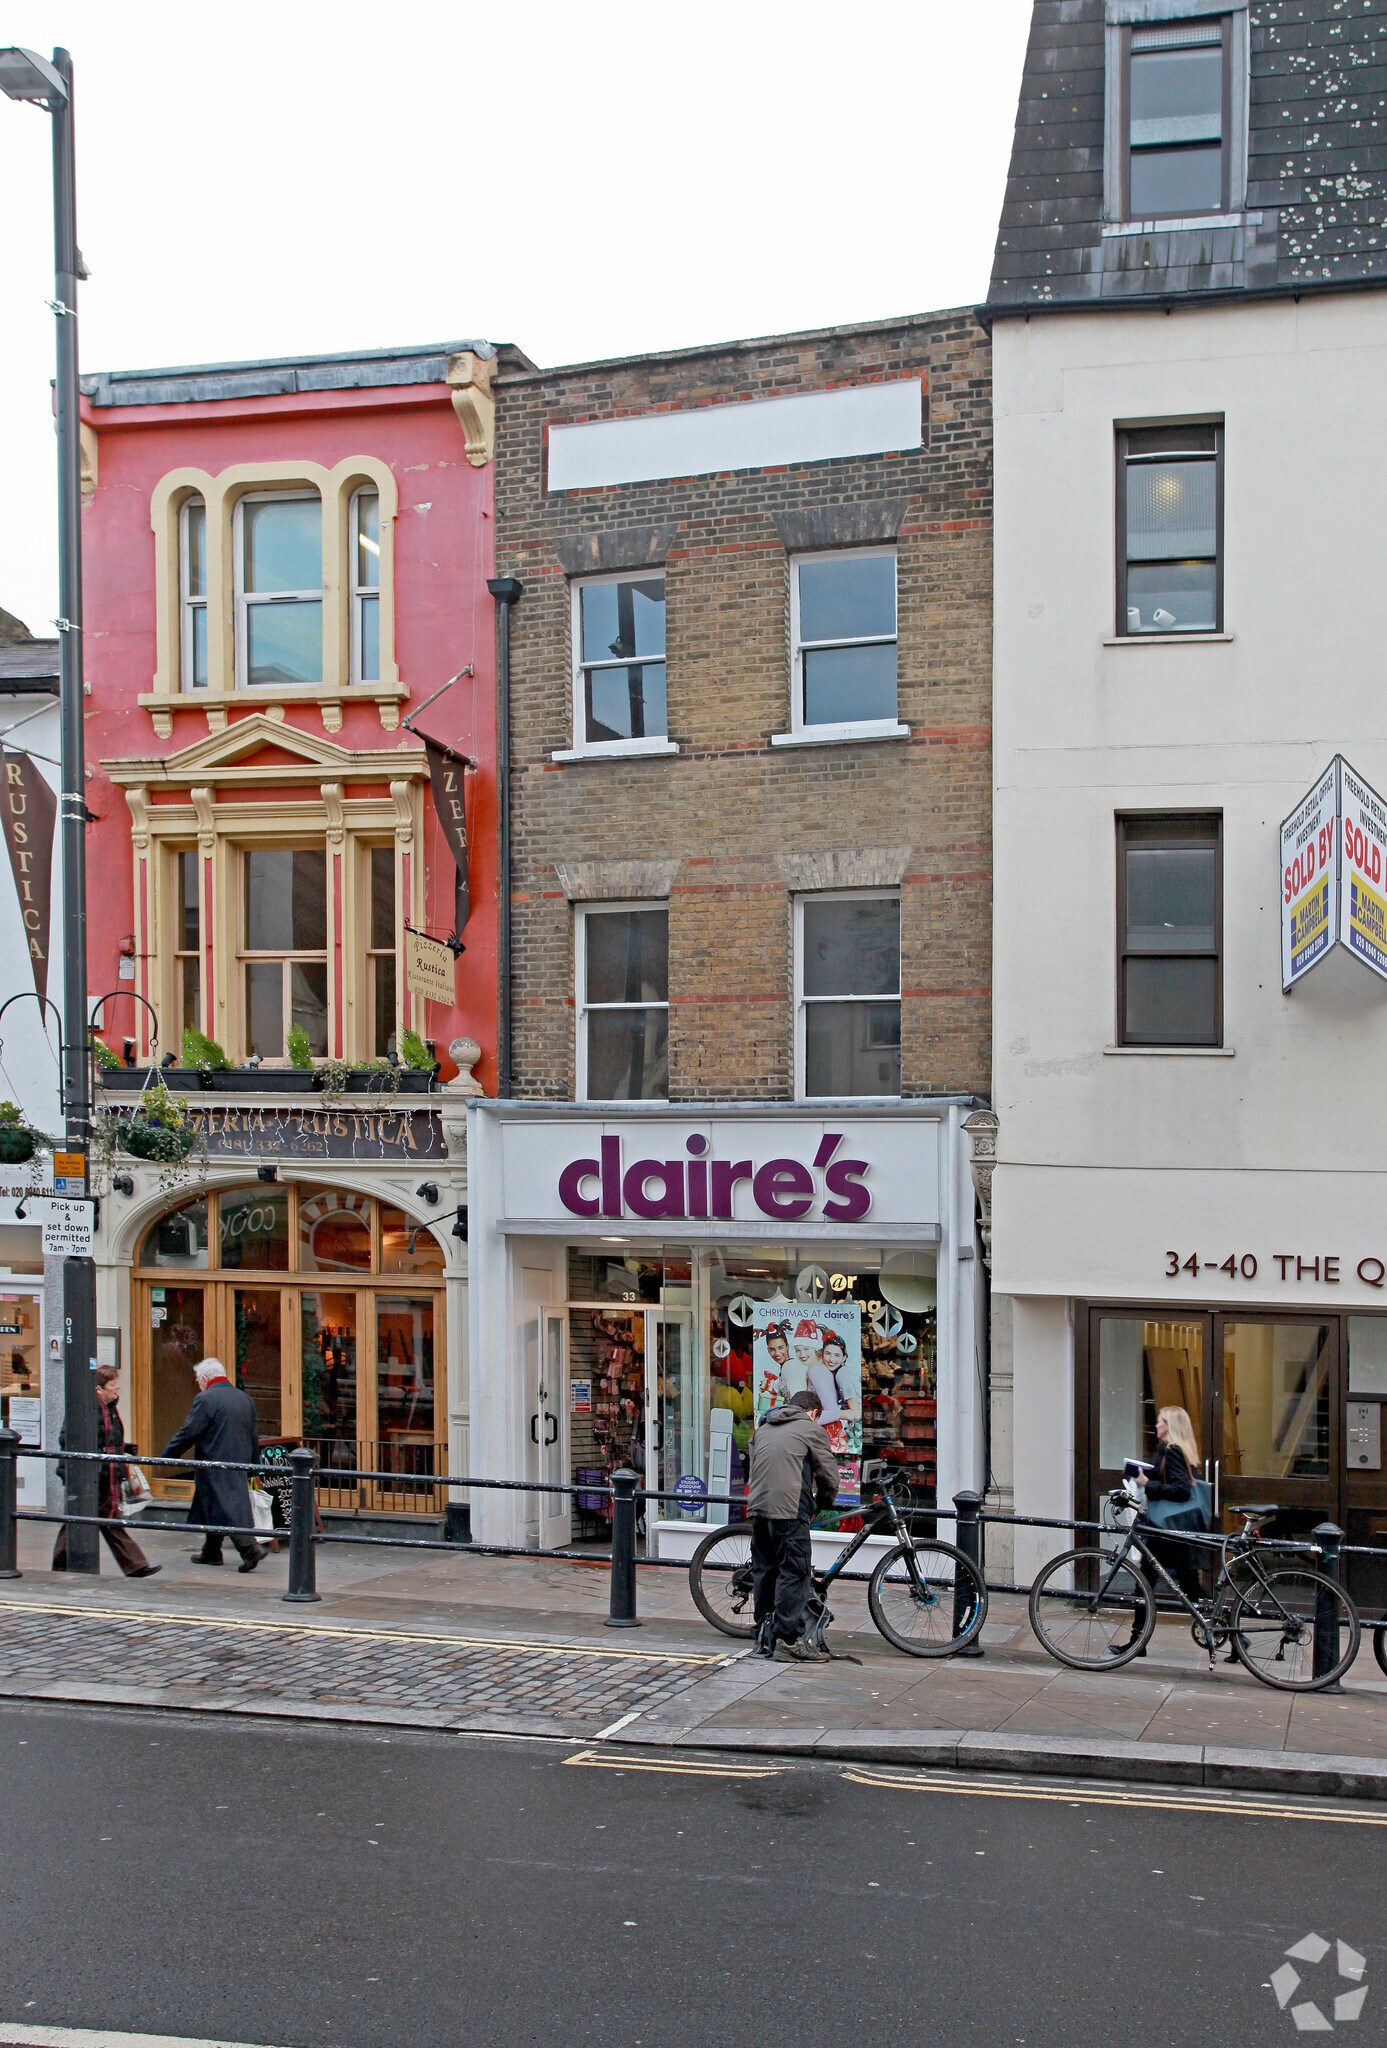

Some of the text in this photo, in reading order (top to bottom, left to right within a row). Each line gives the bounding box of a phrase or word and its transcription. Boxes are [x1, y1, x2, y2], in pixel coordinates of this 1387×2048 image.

[1283, 772, 1334, 844] FREEHOLD RETAIL OFFICE
[1344, 771, 1387, 827] FREEHOLD RETAIL
[1296, 808, 1322, 850] INVESTMENT
[6, 763, 46, 959] RUSTICA
[1284, 841, 1315, 904] SOLD
[1319, 816, 1335, 870] BY
[1344, 817, 1381, 885] SOLD
[1296, 906, 1323, 944] CAMPBELL
[1299, 892, 1320, 925] MARTIN
[1357, 906, 1387, 944] CAMPBELL
[1361, 892, 1385, 926] MARTIN
[413, 938, 448, 962] Pizzeria
[1355, 933, 1365, 949] 020
[416, 957, 446, 977] Rustica
[1296, 955, 1304, 967] 020
[291, 1113, 418, 1150] RUSTICA
[0, 1186, 10, 1197] Tel:
[11, 1187, 24, 1197] 020
[558, 1132, 873, 1220] claire's
[51, 1202, 85, 1213] Pick up
[64, 1213, 71, 1221] &
[45, 1233, 91, 1243] permitted
[47, 1223, 89, 1232] set down
[49, 1243, 64, 1252] 7am
[71, 1244, 87, 1253] 7pm
[1165, 1250, 1386, 1288] 34-40 THE Q
[622, 1292, 636, 1301] 33
[759, 1308, 855, 1320] CHRISTMAS AT claire's
